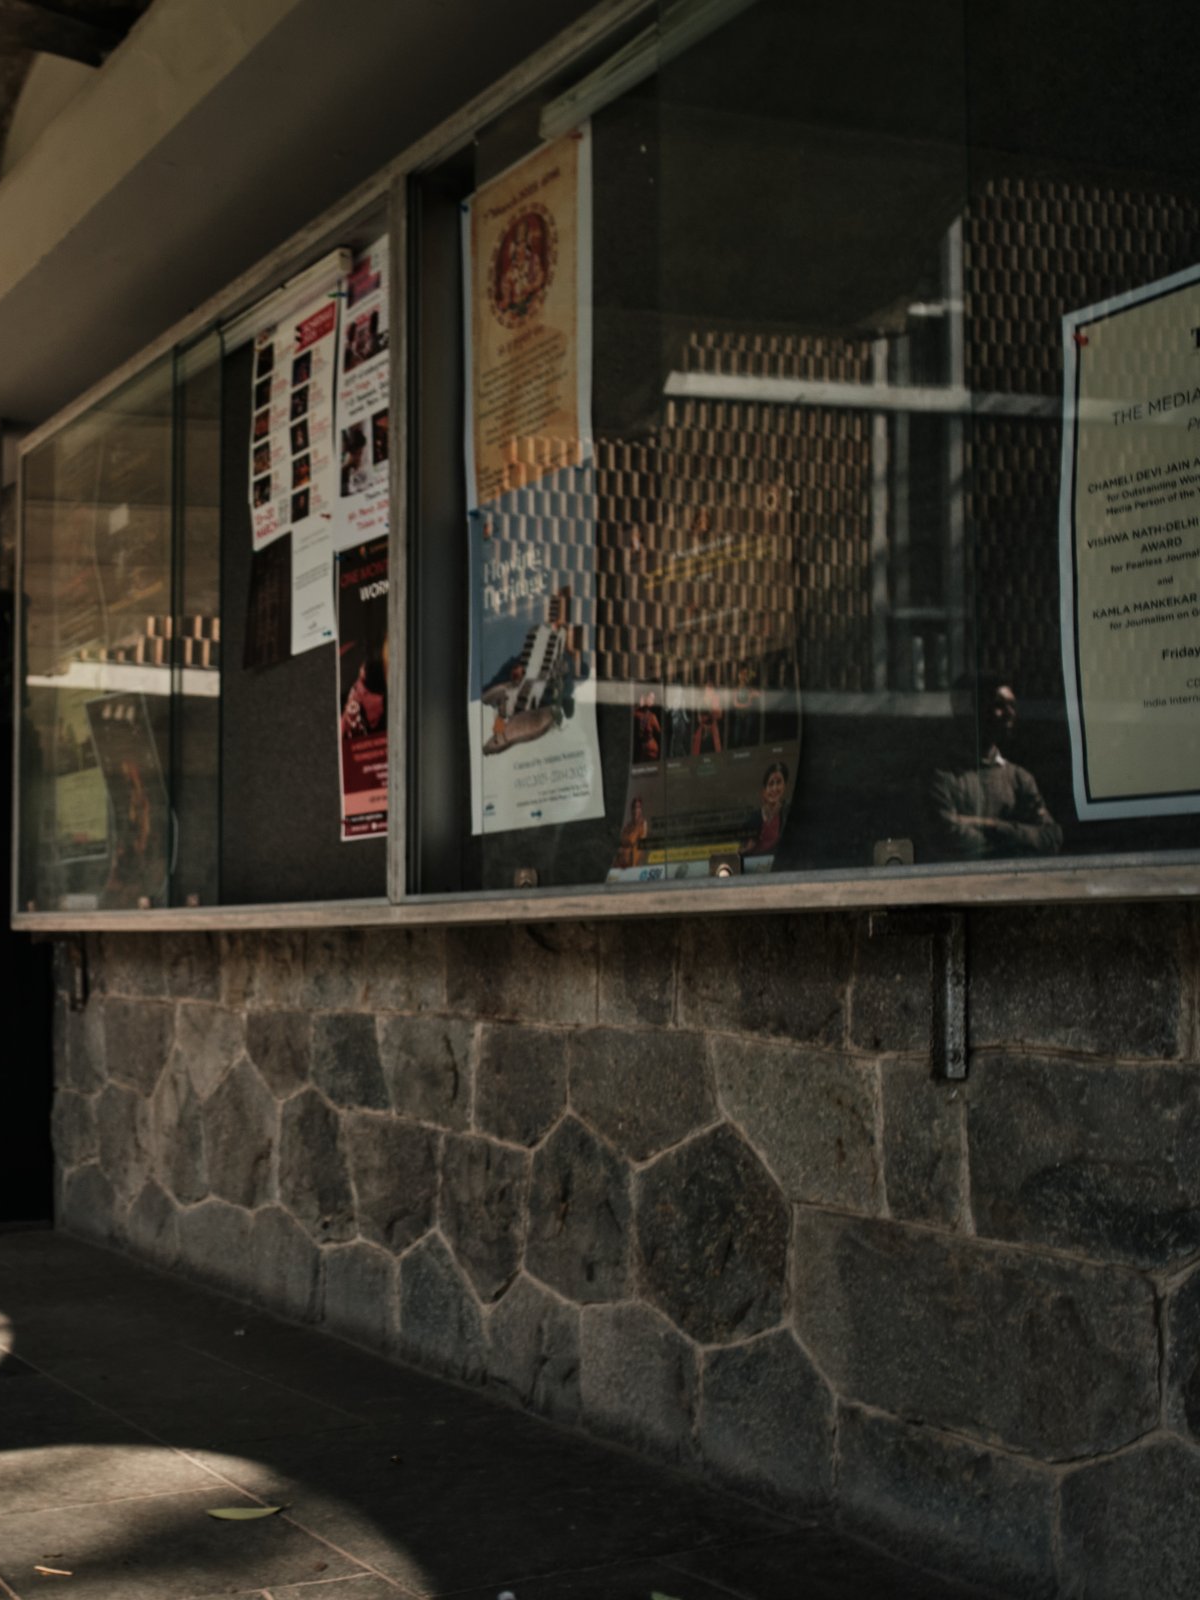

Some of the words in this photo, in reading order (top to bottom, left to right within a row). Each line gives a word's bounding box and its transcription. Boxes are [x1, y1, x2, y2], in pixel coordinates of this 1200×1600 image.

[1112, 404, 1143, 427] THE
[1088, 474, 1133, 495] CHAMELI
[1136, 466, 1161, 482] DEVI
[1165, 459, 1190, 475] JAIN
[1107, 493, 1119, 503] for
[1122, 480, 1177, 499] Outstanding
[1106, 503, 1132, 516] Media
[1135, 497, 1165, 510] Person
[1168, 494, 1177, 503] of
[1179, 489, 1195, 501] the
[1087, 531, 1129, 549] VISHWA
[1132, 517, 1198, 540] NATH-DELHI
[1141, 536, 1182, 553] AWARD
[1111, 563, 1123, 574] for
[1126, 557, 1162, 571] Fearless
[1157, 576, 1173, 586] and
[1093, 605, 1130, 620] KAMLA
[1133, 592, 1198, 612] MANKEKAR
[1110, 621, 1122, 630] for
[1125, 612, 1174, 628] Journalism
[1177, 611, 1189, 619] on
[1162, 645, 1200, 661] Friday
[1144, 697, 1167, 708] India
